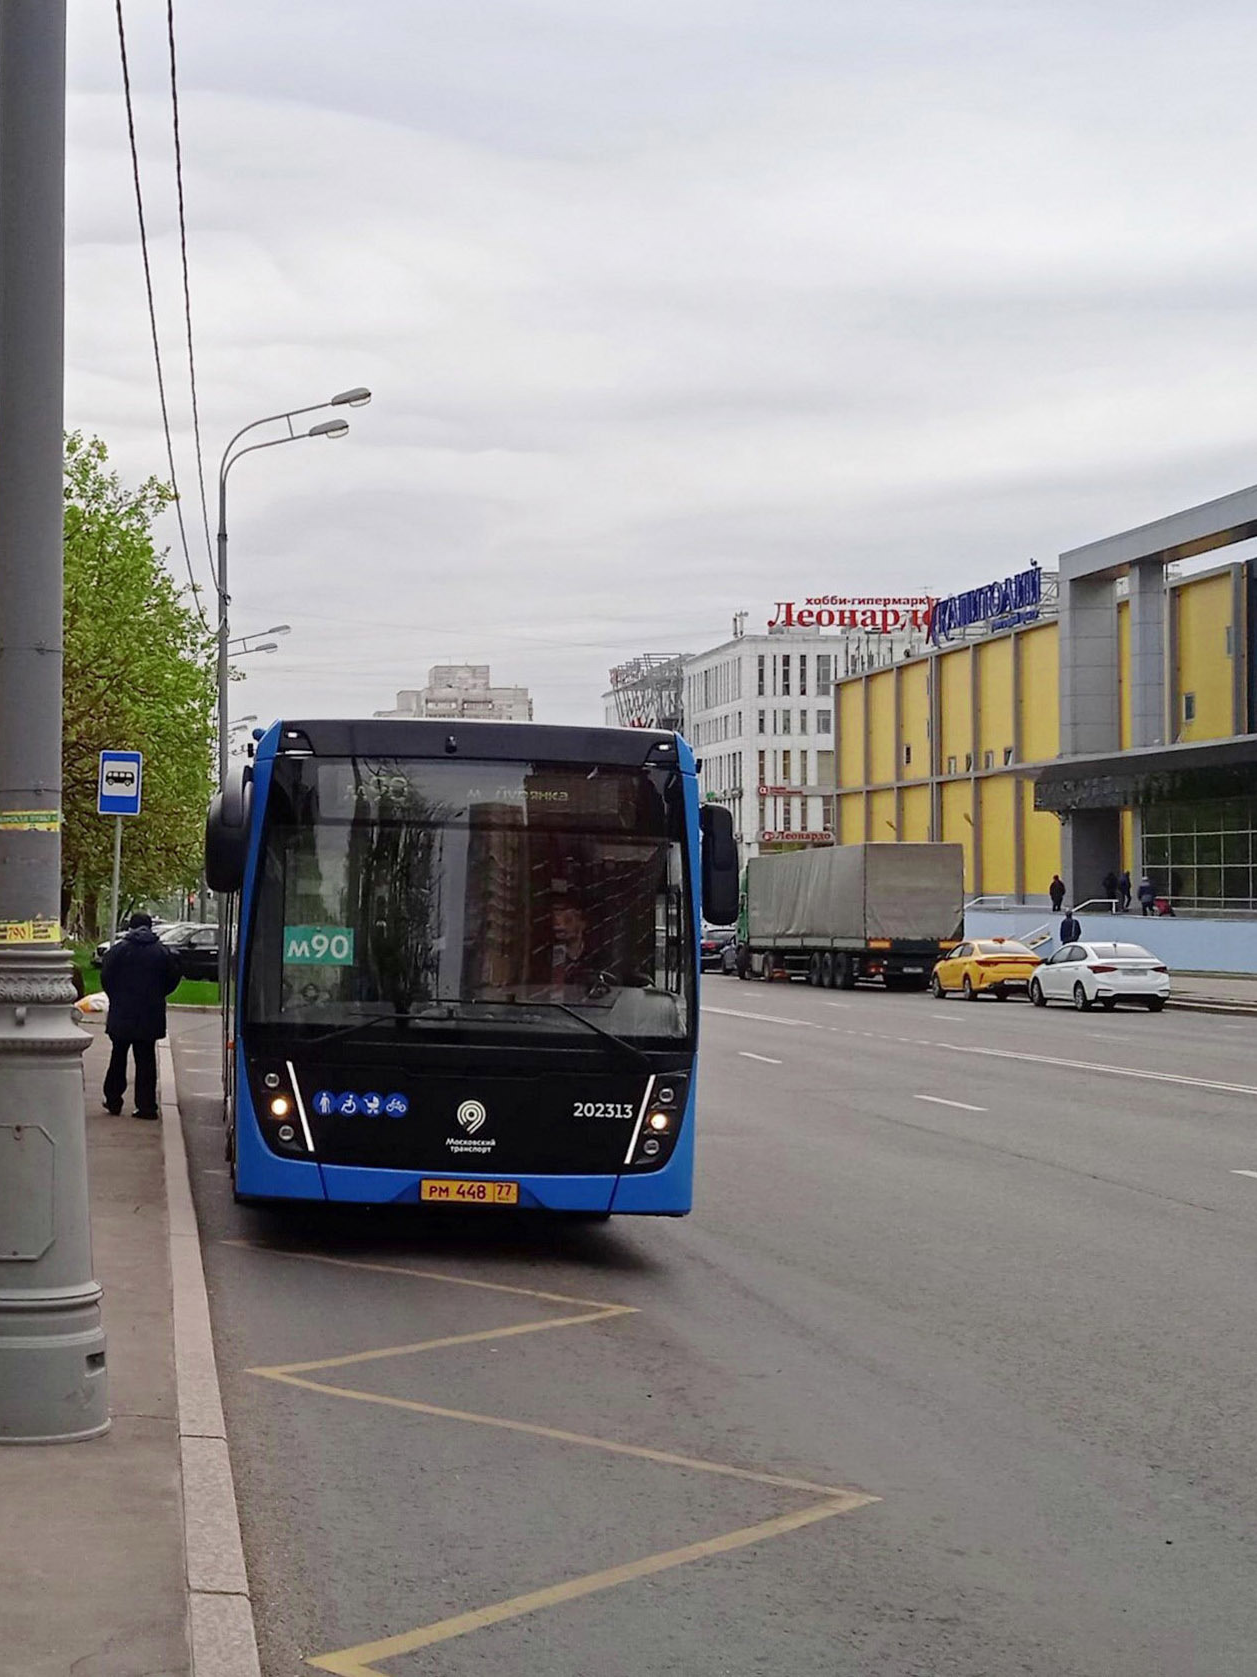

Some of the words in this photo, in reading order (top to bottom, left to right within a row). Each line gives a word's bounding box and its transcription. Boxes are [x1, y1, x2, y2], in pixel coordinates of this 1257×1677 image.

[287, 934, 349, 959] м90
[573, 1102, 633, 1119] 202313
[445, 1137, 496, 1146] Московский
[450, 1145, 492, 1154] транспорт
[429, 1185, 450, 1198] РМ
[456, 1184, 487, 1199] 448
[496, 1184, 512, 1196] 77
